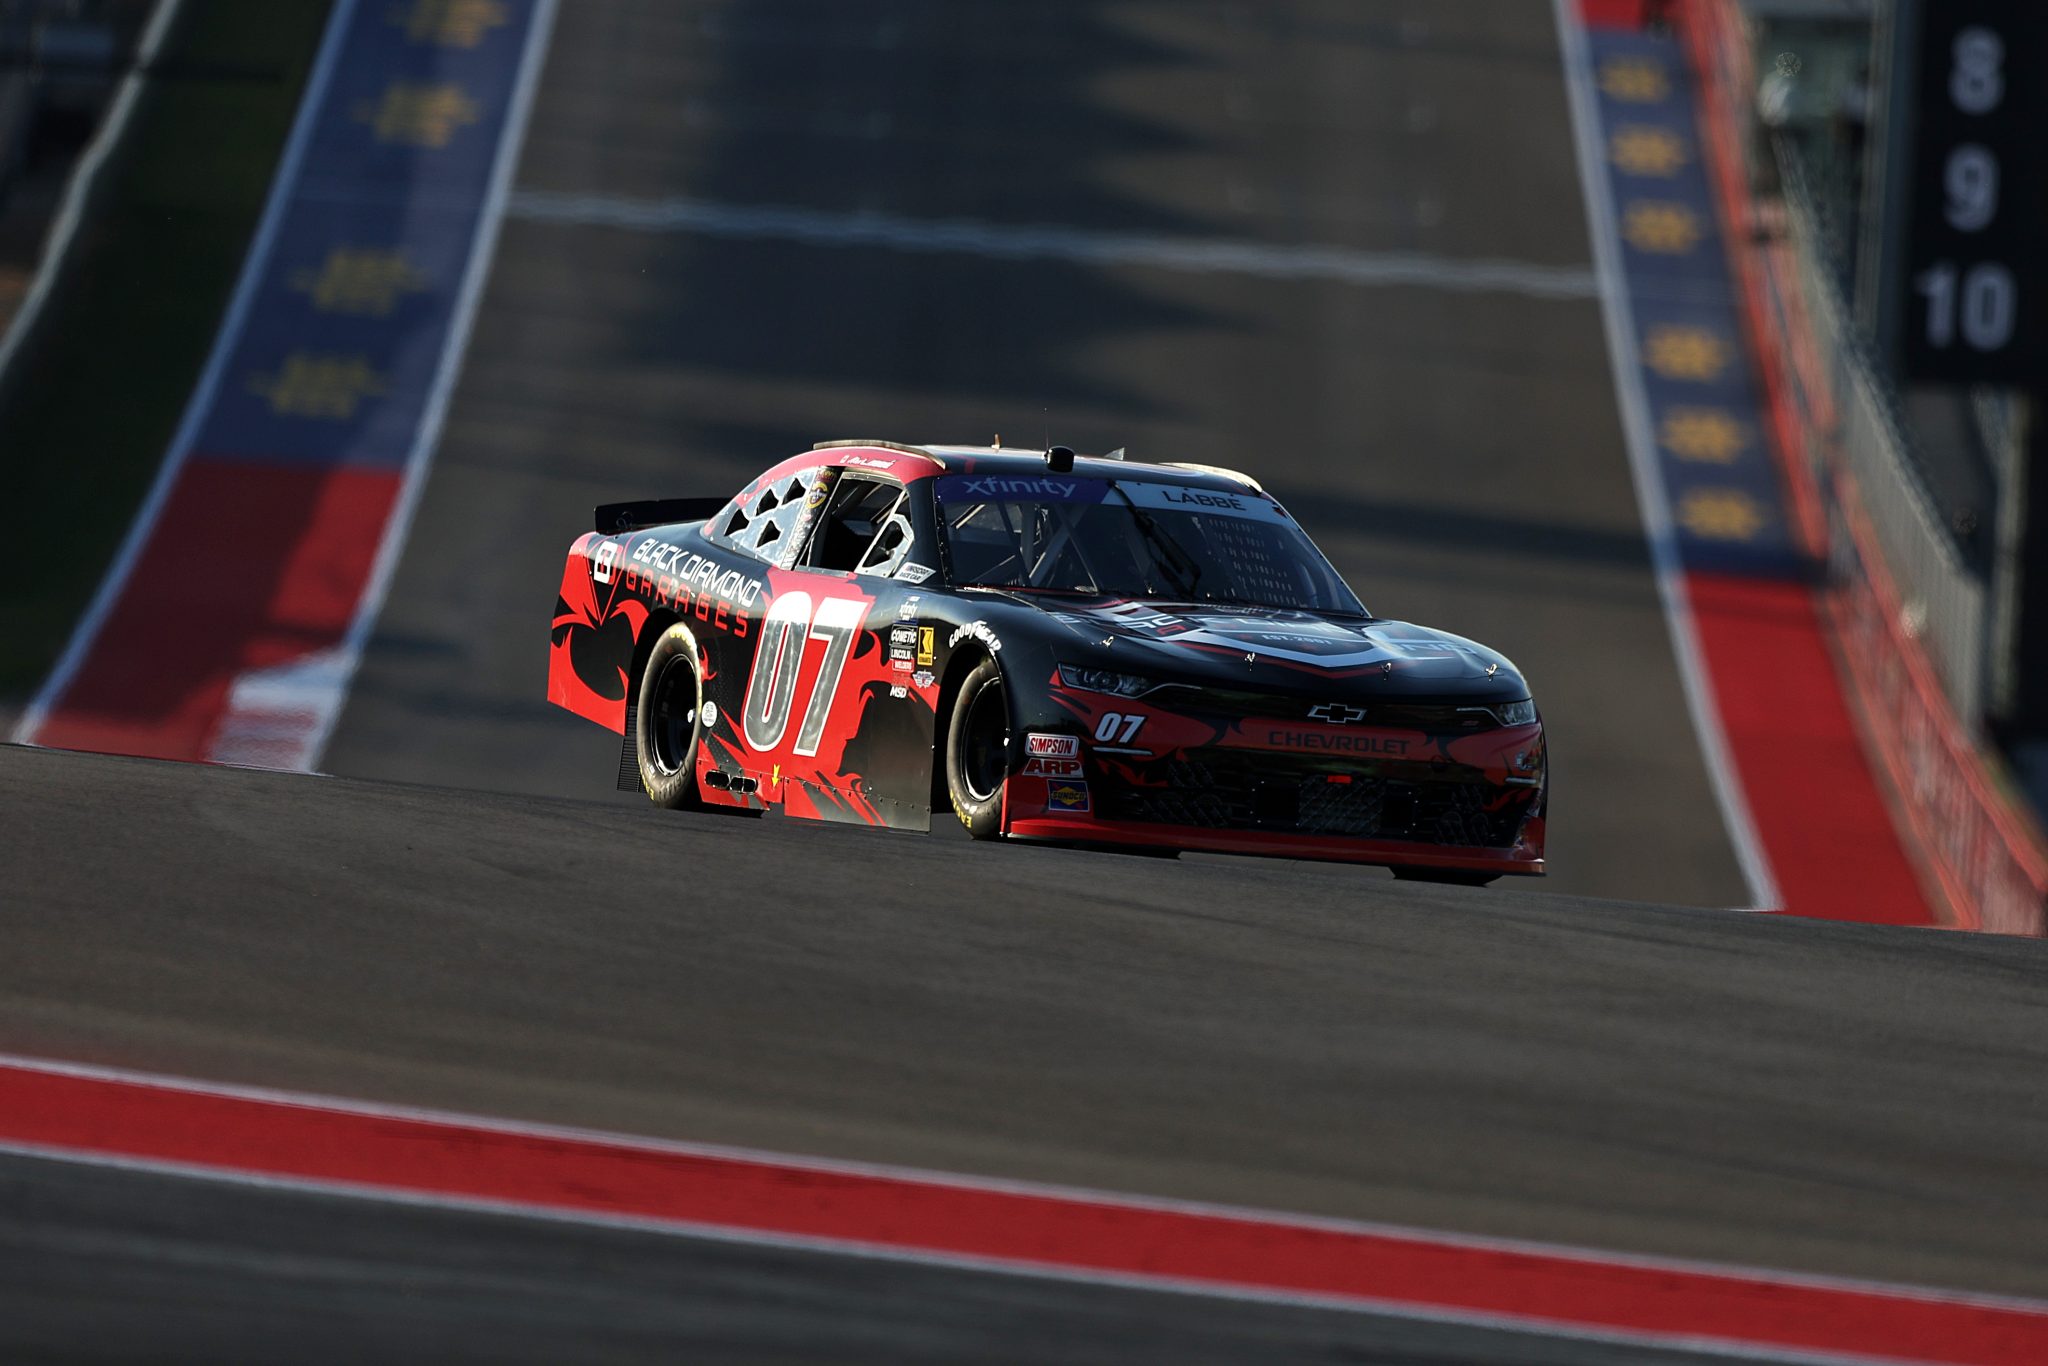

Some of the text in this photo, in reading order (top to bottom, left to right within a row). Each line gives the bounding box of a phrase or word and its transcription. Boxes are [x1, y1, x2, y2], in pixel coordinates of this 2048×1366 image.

[1951, 26, 2003, 114] 8
[1944, 145, 1996, 231] 9
[1917, 263, 2015, 349] 10
[962, 477, 1076, 498] xfinity
[633, 538, 762, 607] BLACK DIAMOND
[626, 563, 749, 638] GARAGES
[743, 590, 869, 757] 07
[890, 686, 907, 698] MSD
[1095, 712, 1146, 743] 07
[1268, 731, 1410, 755] CHEVROLET
[1029, 737, 1073, 754] SIMPSON
[1024, 759, 1080, 775] ARP
[1051, 791, 1087, 800] SUNOCO
